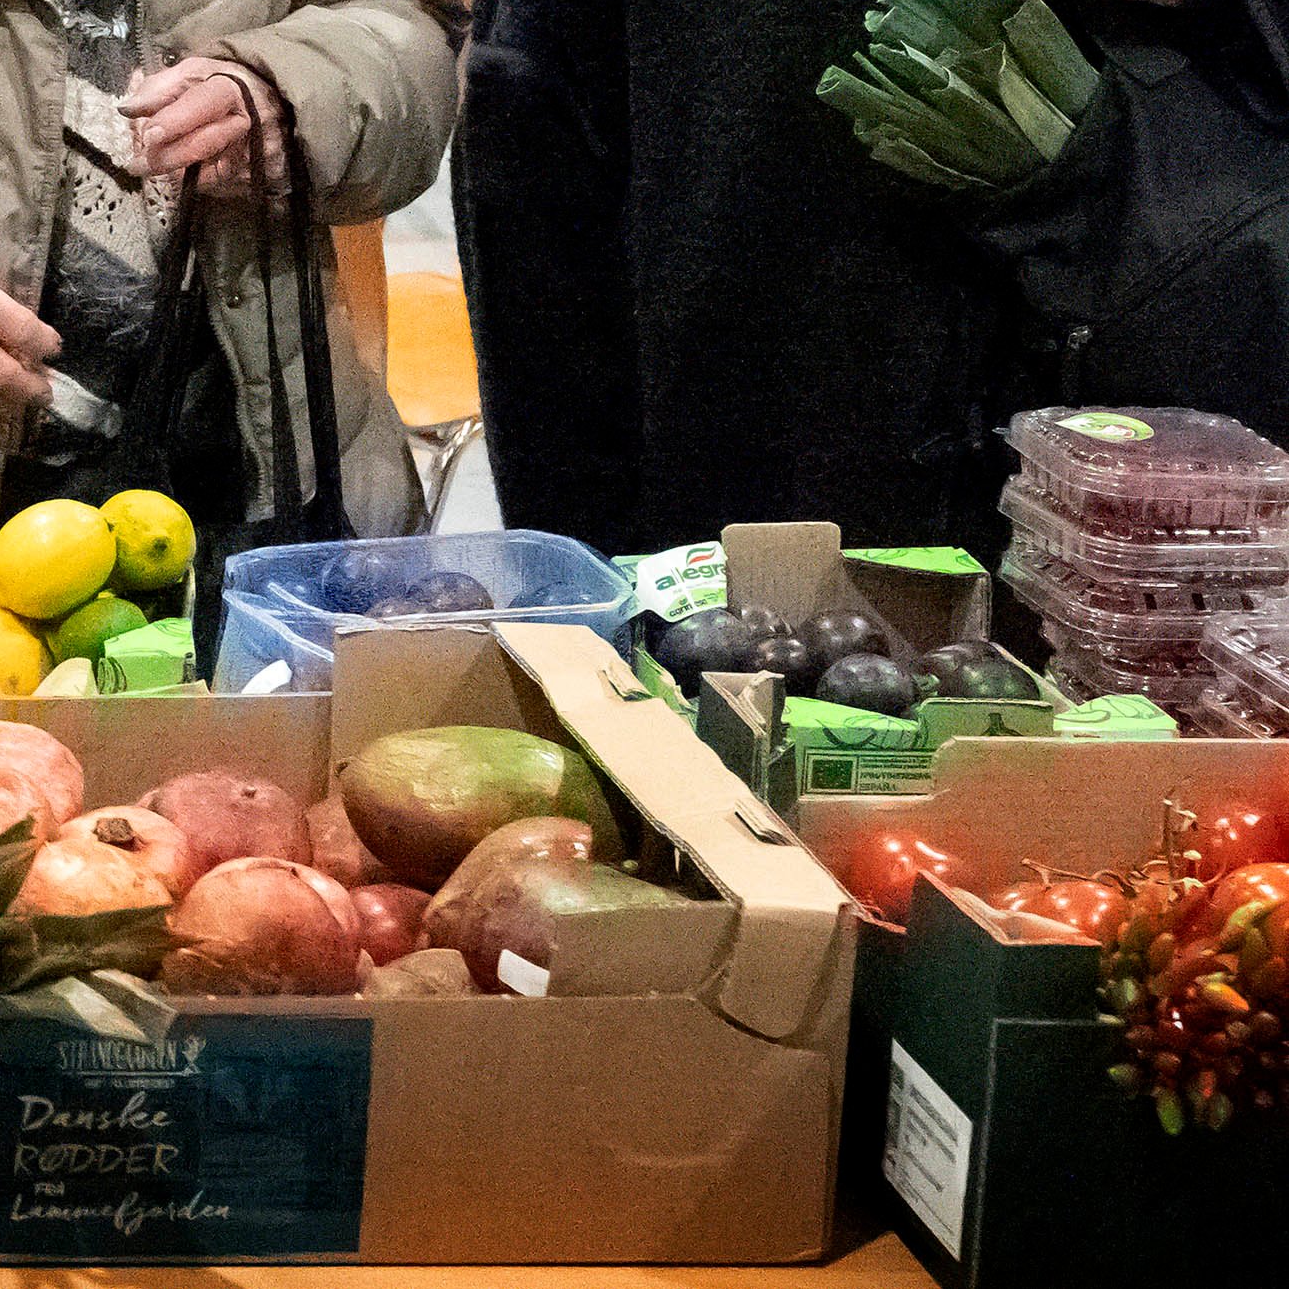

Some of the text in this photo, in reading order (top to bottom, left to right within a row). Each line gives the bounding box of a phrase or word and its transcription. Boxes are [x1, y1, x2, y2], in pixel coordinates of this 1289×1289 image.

[17, 1091, 174, 1131] Danske
[13, 1142, 180, 1176] RØDDER
[10, 1190, 230, 1236] Lammefjorden
